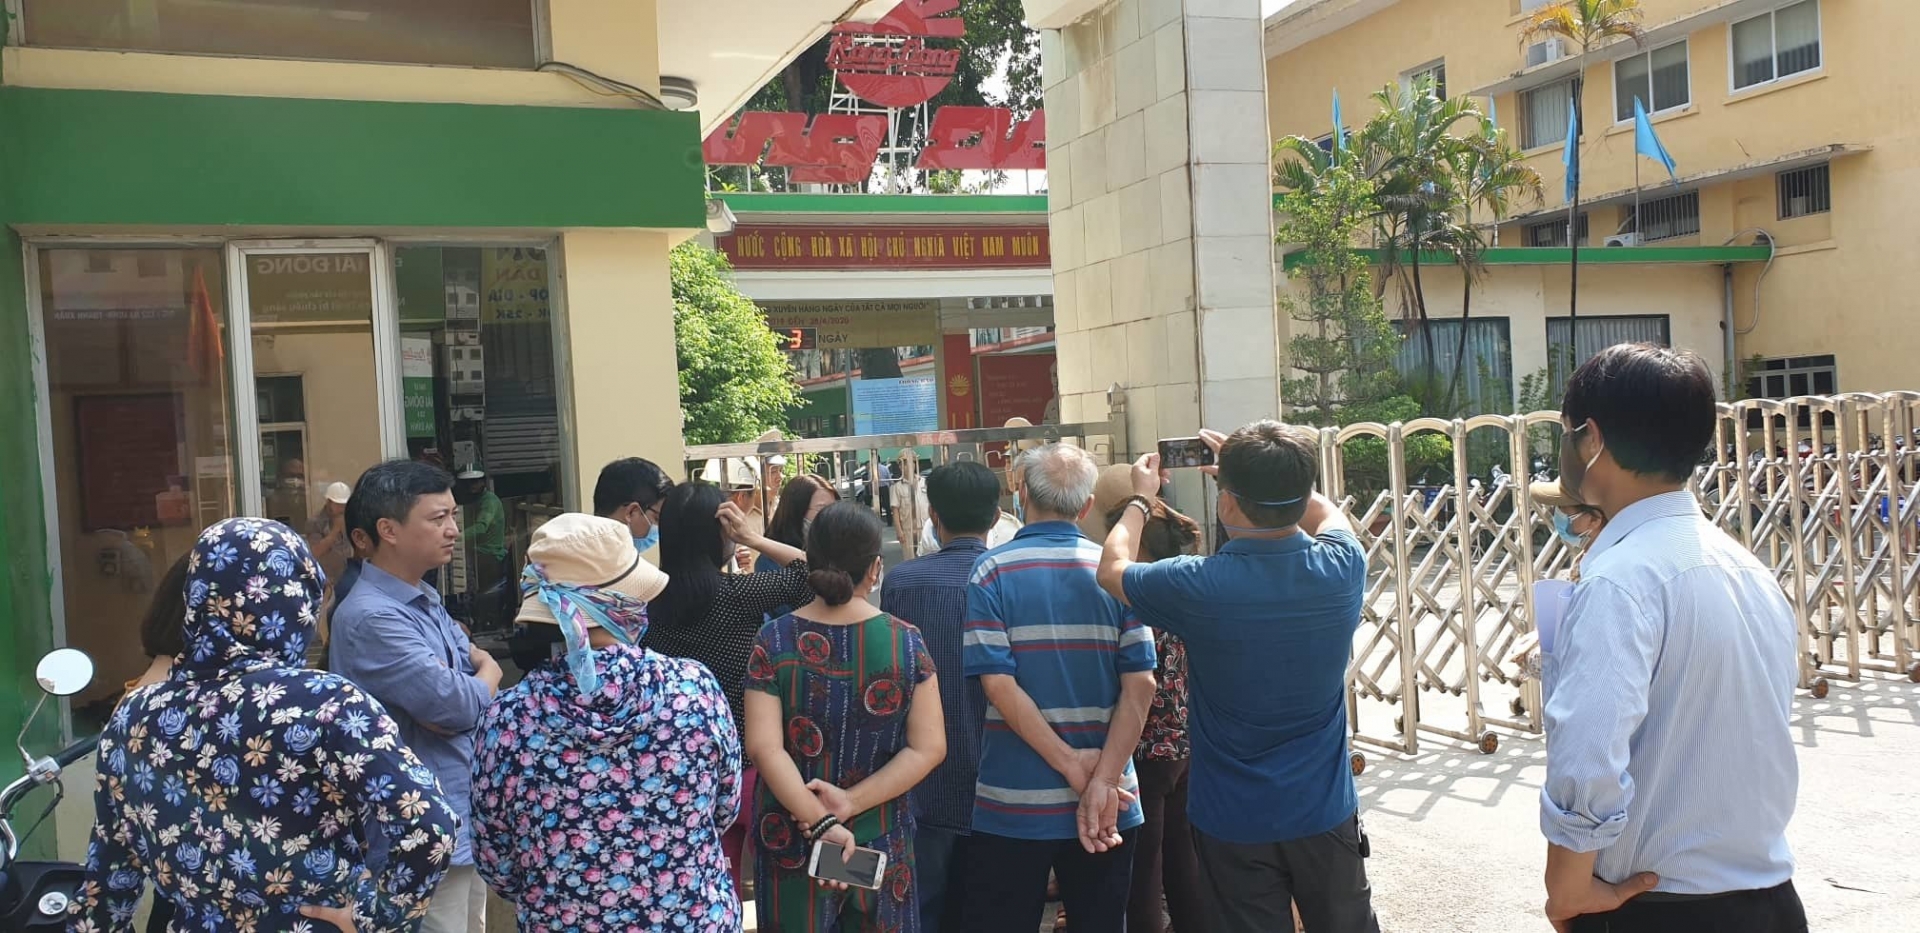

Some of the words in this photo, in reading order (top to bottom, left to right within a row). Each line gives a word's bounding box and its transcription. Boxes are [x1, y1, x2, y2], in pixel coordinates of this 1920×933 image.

[737, 230, 765, 257] NƯỚC
[774, 231, 801, 261] CỘNG
[811, 231, 832, 257] HÒA
[838, 233, 853, 257] XÃ
[861, 232, 878, 261] HỘI
[886, 231, 905, 257] CHỦ
[914, 233, 945, 257] NGHĨA
[952, 232, 975, 260] VIỆT
[982, 236, 1004, 257] NAM
[1012, 231, 1039, 257] MUÔN
[818, 331, 848, 344] NGÀY
